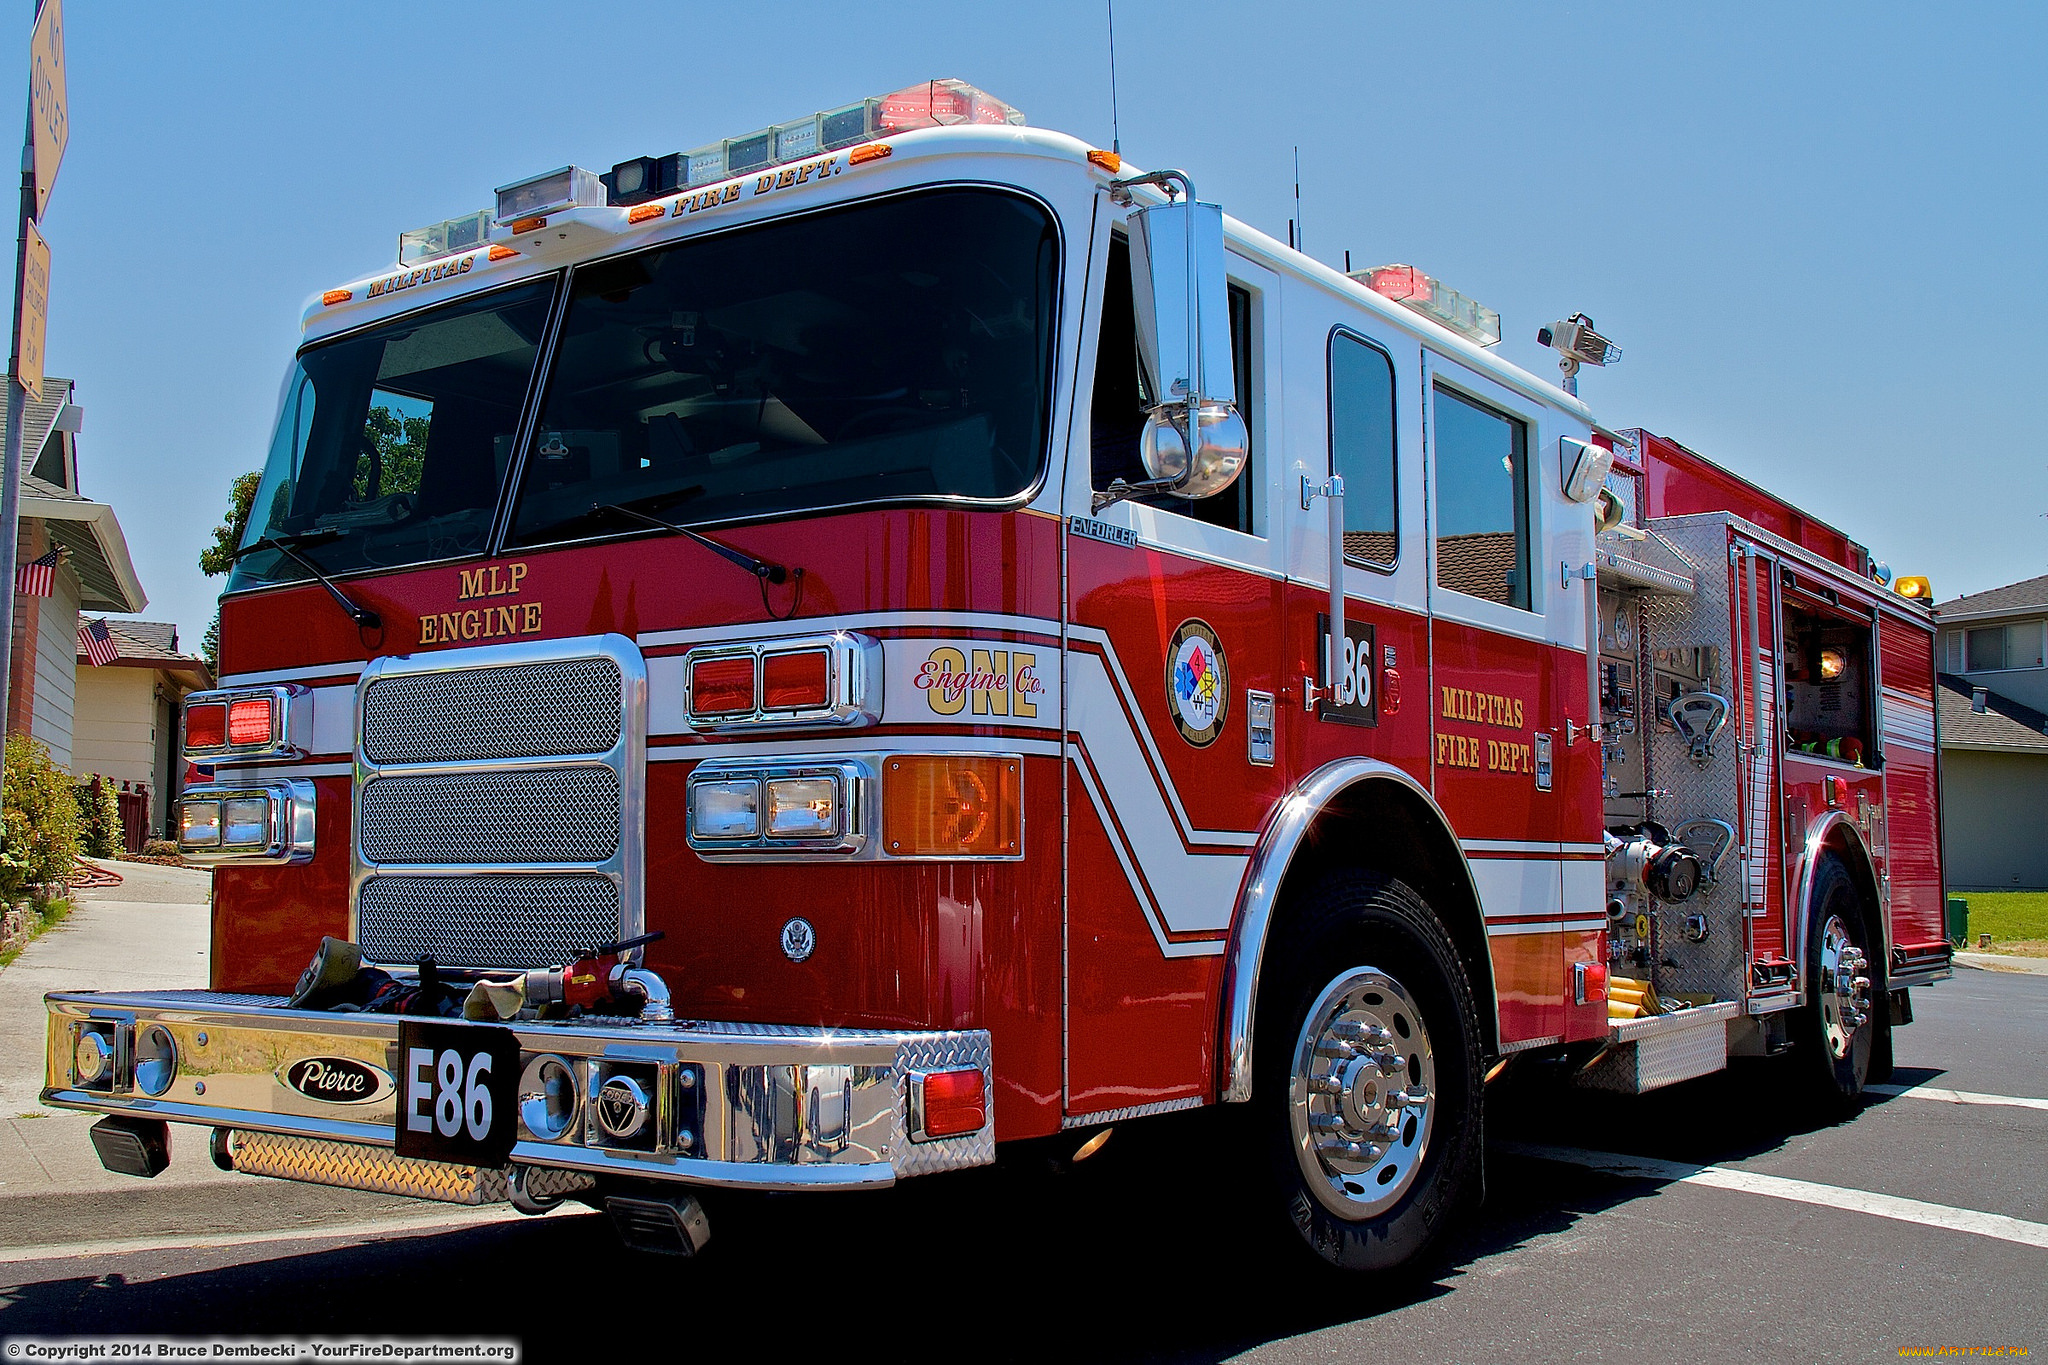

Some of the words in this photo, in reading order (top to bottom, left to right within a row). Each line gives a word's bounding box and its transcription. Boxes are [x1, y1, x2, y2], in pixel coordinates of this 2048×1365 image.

[48, 9, 60, 67] NO
[35, 55, 64, 152] OUTLET
[672, 181, 744, 216] FIRE
[756, 155, 843, 193] DEPT.
[366, 254, 478, 299] MILPITAS
[1071, 516, 1138, 546] ENFORCER
[458, 562, 528, 600] MLP
[419, 602, 542, 645] ENGINE
[913, 661, 1009, 701] Engine
[1015, 665, 1046, 694] Co.
[927, 646, 1037, 718] ONE
[1194, 654, 1201, 669] 4
[1441, 686, 1524, 730] MILPITAS
[1436, 733, 1480, 770] FIRE
[1488, 740, 1534, 775] DEPT.
[299, 1061, 365, 1092] Pierce
[406, 1047, 493, 1141] E86
